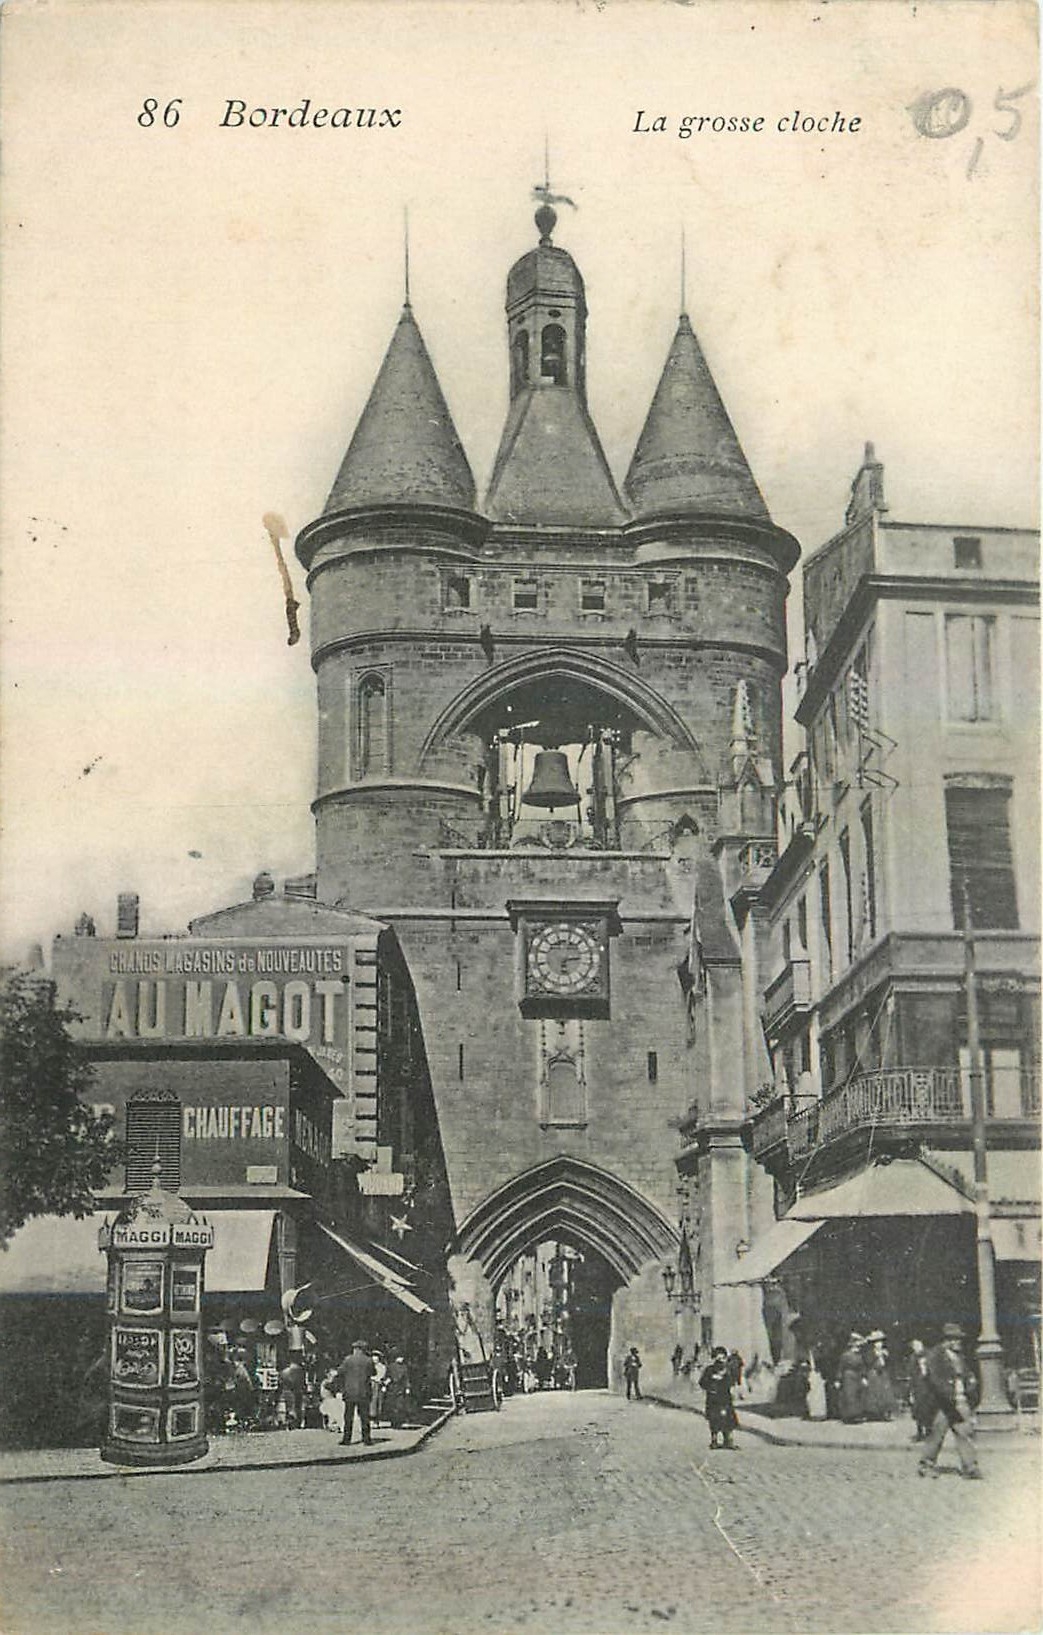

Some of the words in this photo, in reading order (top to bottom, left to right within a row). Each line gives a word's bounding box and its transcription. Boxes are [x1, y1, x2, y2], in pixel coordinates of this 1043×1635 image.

[106, 980, 166, 1037] AU
[184, 979, 344, 1043] MAGOT
[183, 1105, 286, 1139] CHAUFFAGE
[116, 1230, 167, 1244] MAGGI
[175, 1231, 212, 1244] MAGGI
